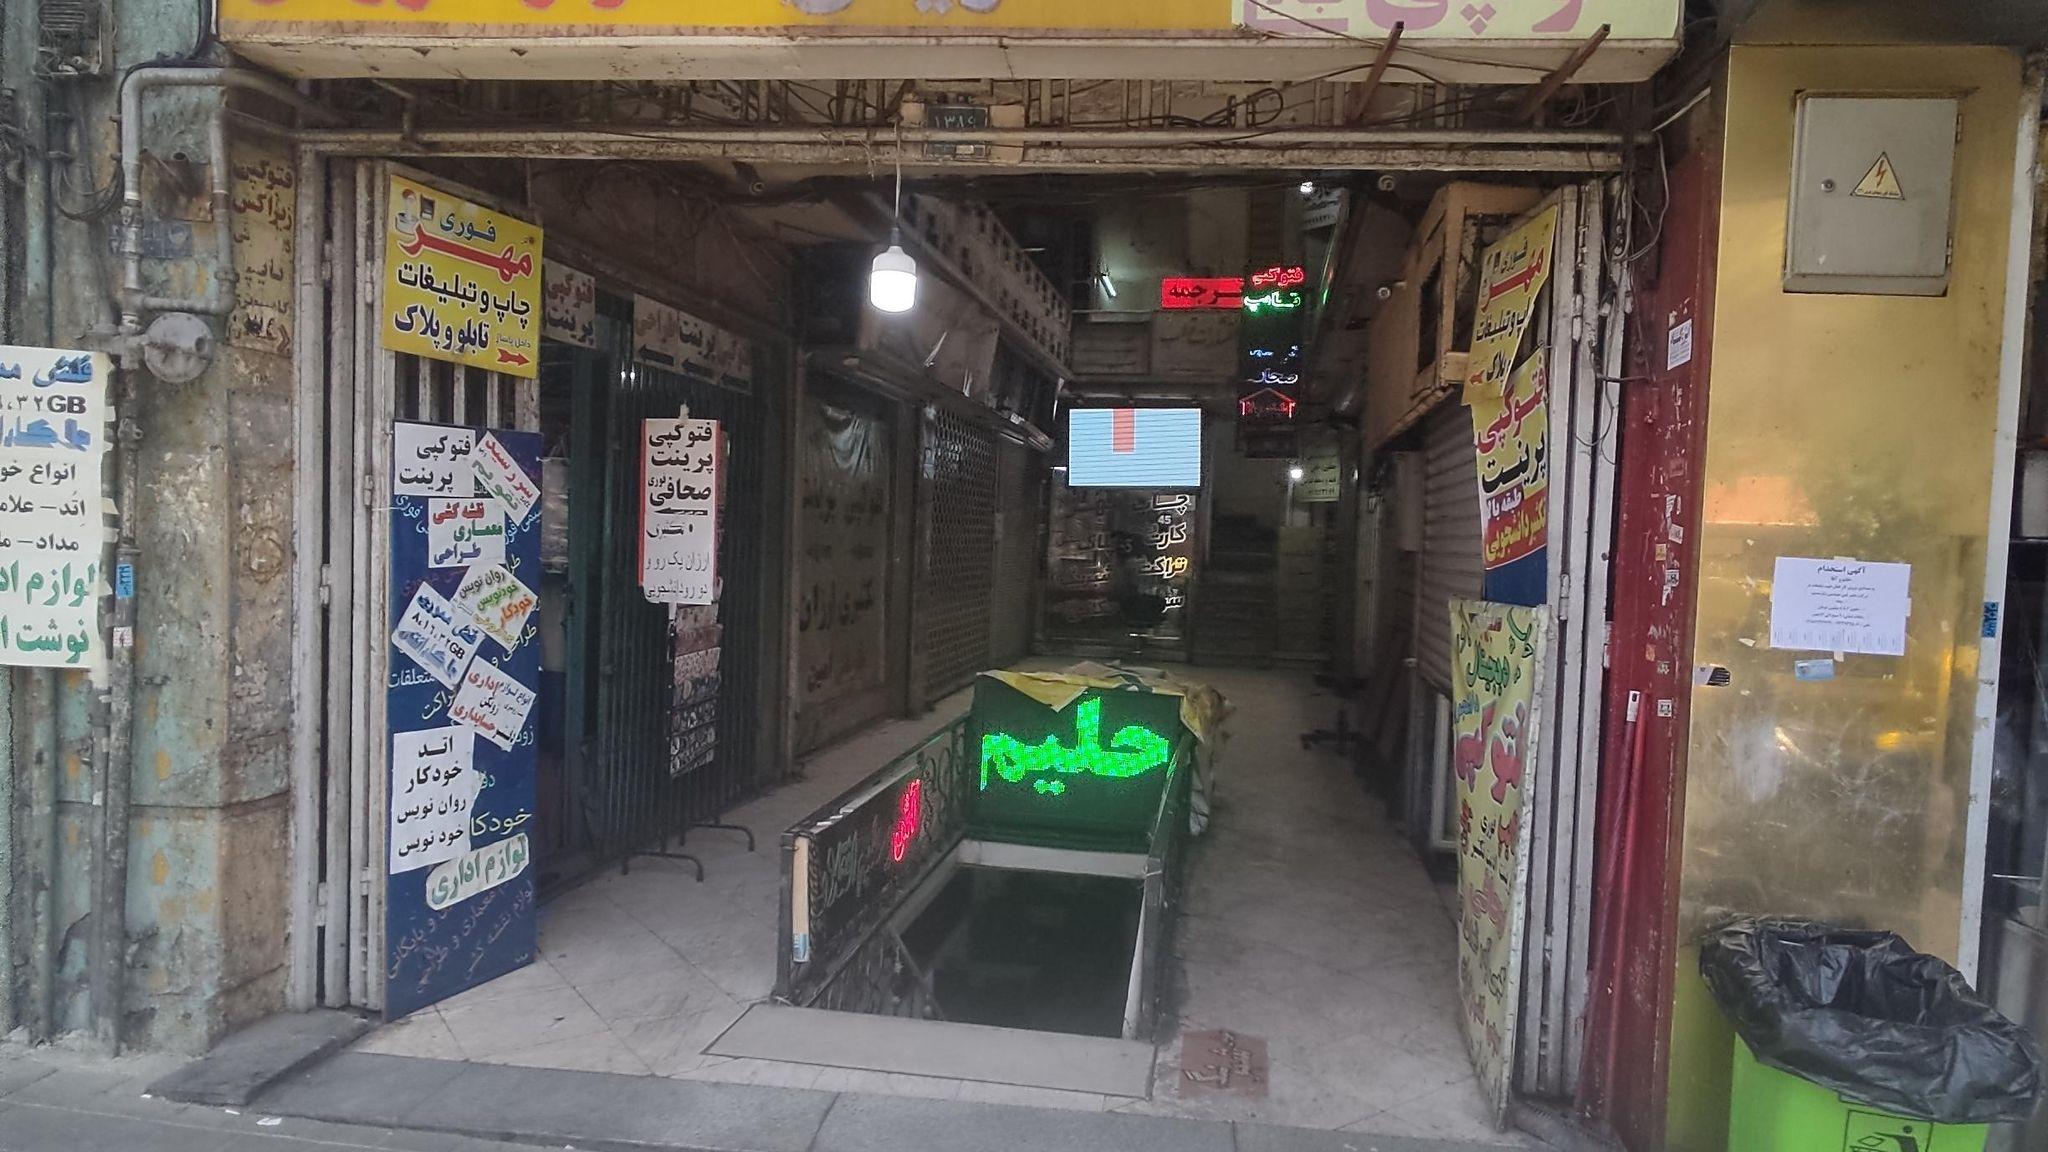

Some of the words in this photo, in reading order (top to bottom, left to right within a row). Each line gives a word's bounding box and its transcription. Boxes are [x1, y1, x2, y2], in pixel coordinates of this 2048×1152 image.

[440, 211, 496, 242] فوری
[399, 223, 533, 284] مهر
[398, 262, 477, 309] تبلیغات
[480, 289, 489, 314] و
[492, 290, 531, 330] چاپ
[394, 305, 440, 349] پلاک
[442, 324, 453, 350] و
[457, 319, 490, 354] تابلو
[416, 435, 471, 461] فتوکپی
[648, 422, 713, 448] فتوکپی
[29, 462, 75, 485] انواع
[651, 450, 714, 474] پرینت
[399, 467, 453, 493] پرینت
[649, 477, 712, 506] صحافی
[432, 501, 460, 524] کشی
[462, 501, 485, 519] نقشه
[453, 519, 504, 542] معماری
[433, 542, 481, 564] طراحی
[484, 568, 505, 586] روان
[1817, 564, 1846, 576] استخدام
[1847, 566, 1865, 576] آگهی
[16, 618, 90, 664] نوشت
[418, 735, 453, 758] اتد
[980, 697, 1170, 797] حلیم
[404, 761, 463, 794] خودکار
[396, 801, 434, 825] نویس
[438, 793, 467, 816] روان
[438, 824, 465, 847] خود
[470, 807, 533, 838] خودکا
[398, 831, 436, 858] نویس
[484, 834, 527, 884] لوازم
[430, 853, 483, 906] اداری
